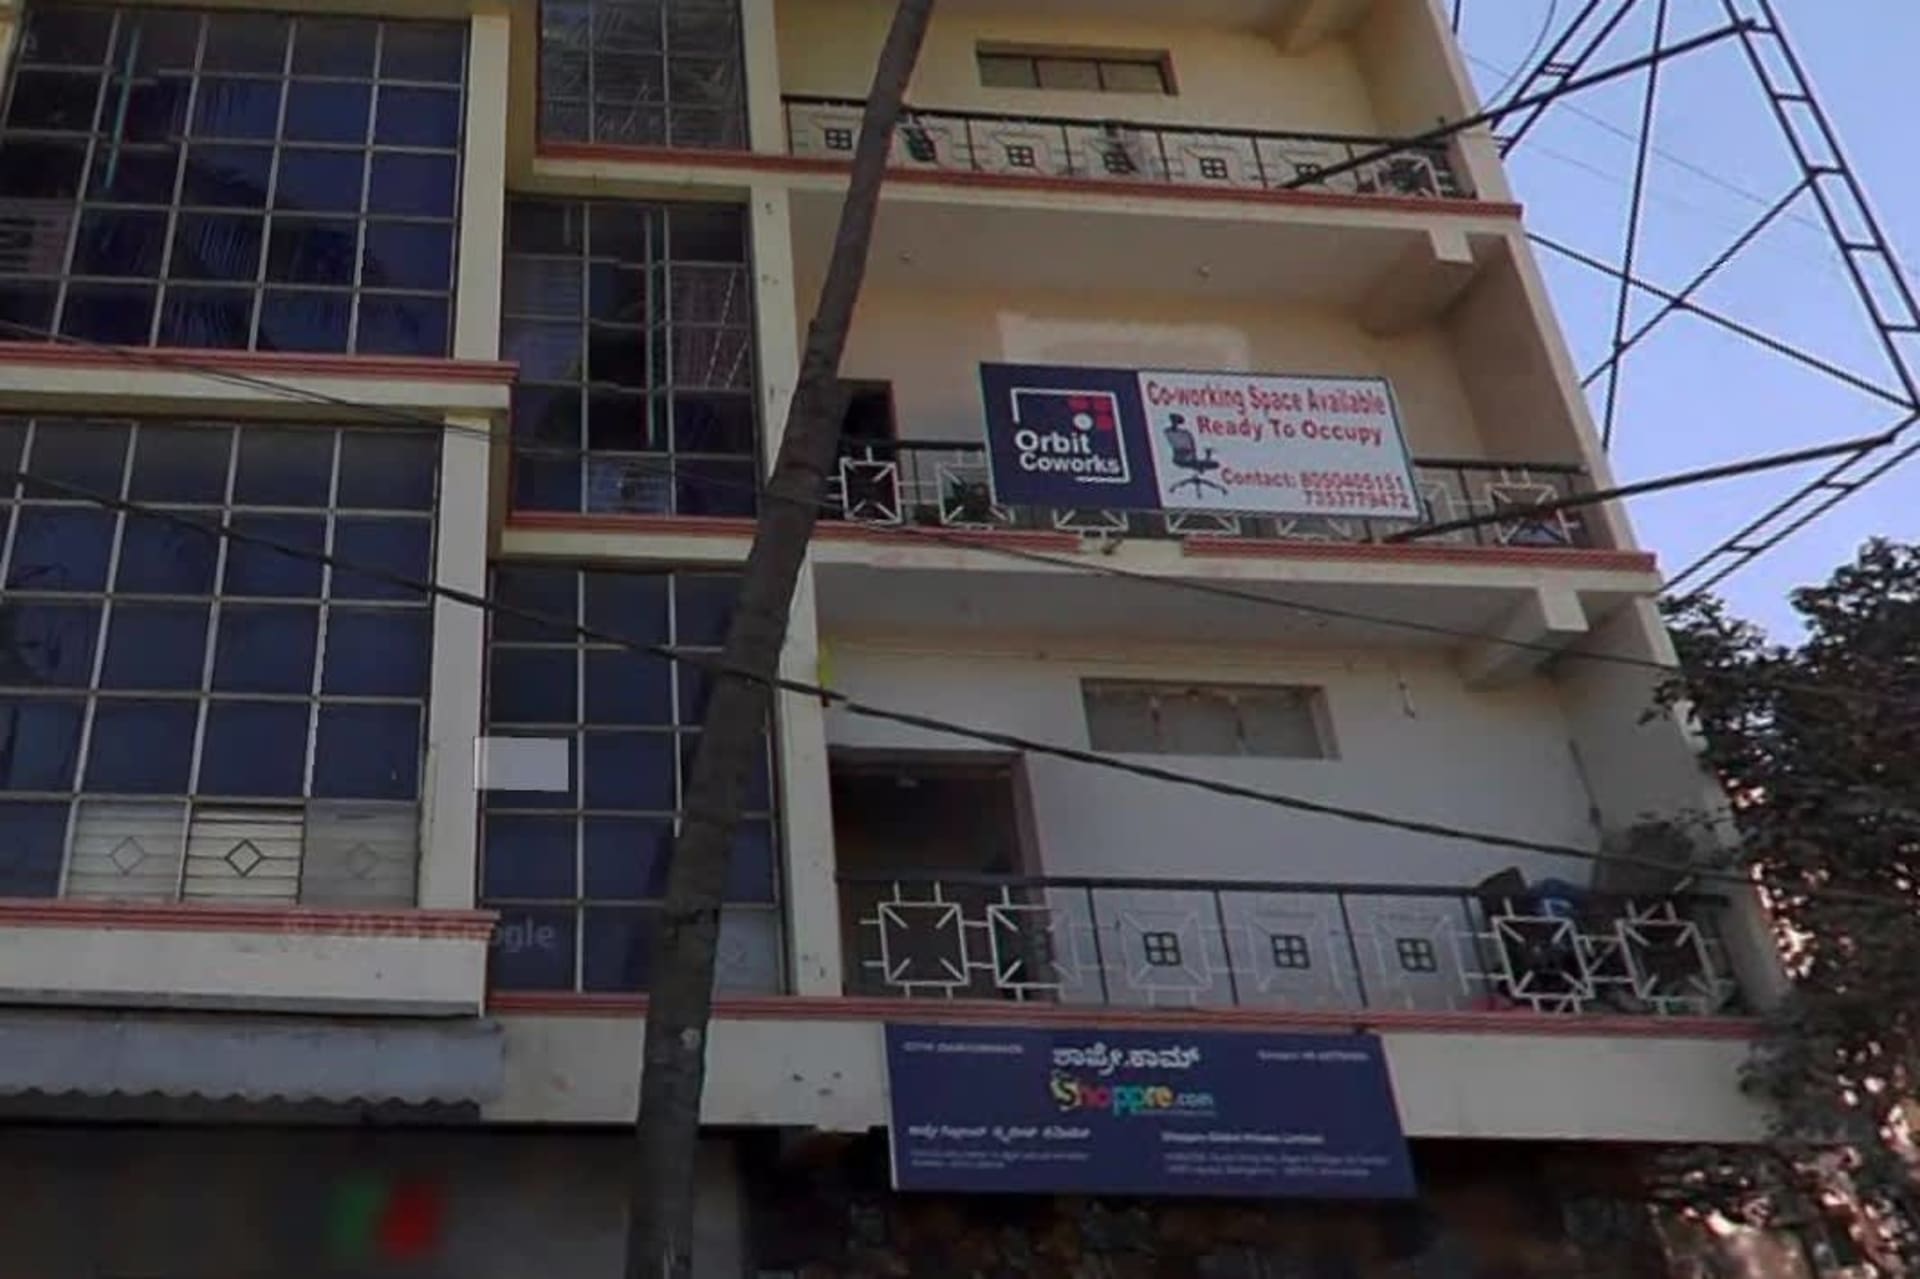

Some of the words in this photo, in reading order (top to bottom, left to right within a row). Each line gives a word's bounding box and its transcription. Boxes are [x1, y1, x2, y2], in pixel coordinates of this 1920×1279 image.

[1147, 381, 1245, 415] Co-working
[1249, 385, 1303, 417] Space
[1307, 388, 1386, 415] Available
[1015, 429, 1091, 454] Orbit
[1197, 414, 1263, 442] Ready
[1268, 418, 1297, 438] To
[1301, 419, 1382, 446] Occupy
[1019, 451, 1121, 475] Coworks
[1220, 467, 1296, 488] Contact:
